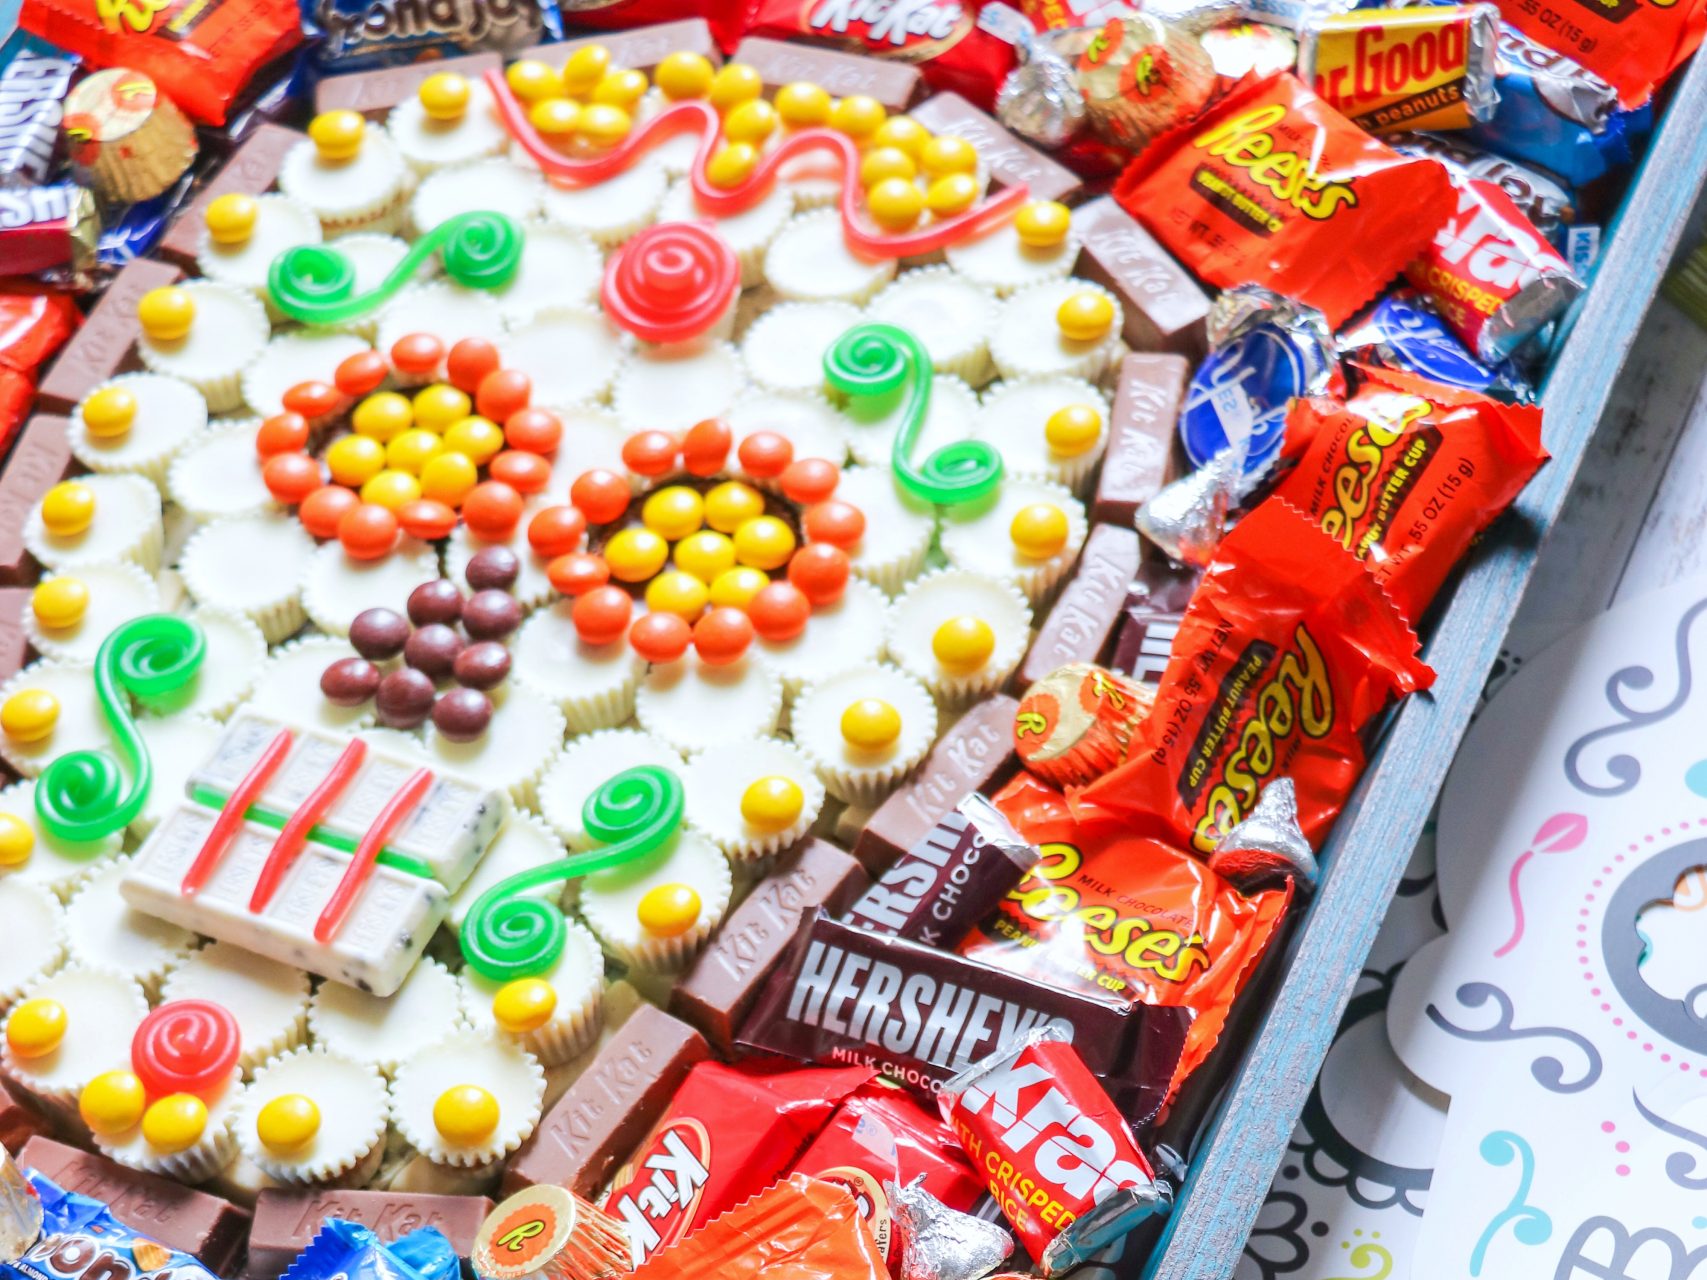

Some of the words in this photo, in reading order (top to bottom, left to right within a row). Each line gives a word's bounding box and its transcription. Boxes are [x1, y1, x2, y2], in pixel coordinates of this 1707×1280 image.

[1375, 84, 1460, 126] peanuts
[1375, 466, 1410, 523] BUTTER
[1402, 437, 1428, 469] CUP
[1422, 496, 1446, 521] OZ
[1458, 457, 1477, 480] g)
[1227, 655, 1262, 708] PEANUT
[1016, 710, 1048, 739] R
[1173, 696, 1193, 723] OZ
[1203, 704, 1235, 759] BUTTER
[1188, 758, 1209, 788] CUP
[1006, 840, 1211, 983] Reese's
[1076, 873, 1117, 899] MILK
[1115, 893, 1195, 931] CHOCOLATE
[1096, 971, 1127, 994] CUP
[831, 1044, 877, 1073] MILK
[495, 1219, 547, 1252] R
